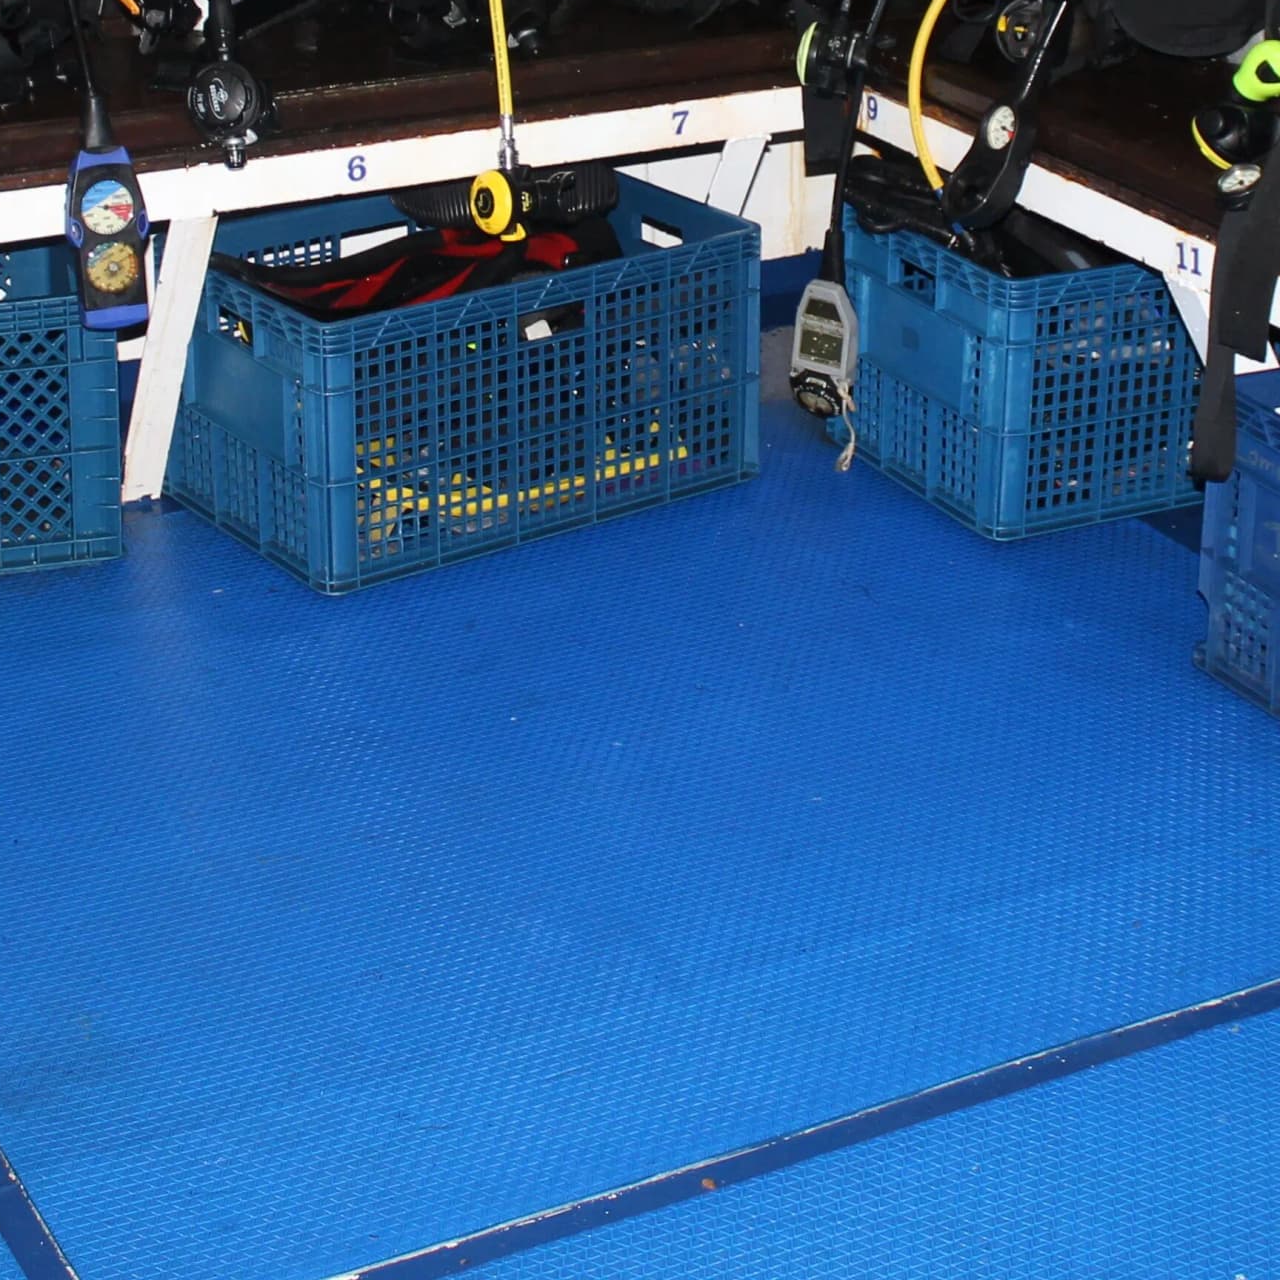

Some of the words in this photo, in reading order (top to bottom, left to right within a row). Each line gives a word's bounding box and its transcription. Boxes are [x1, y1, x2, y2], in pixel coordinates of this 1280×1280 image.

[866, 95, 878, 121] 9
[671, 110, 690, 136] 7
[347, 155, 367, 182] 6
[1175, 242, 1202, 276] 11
